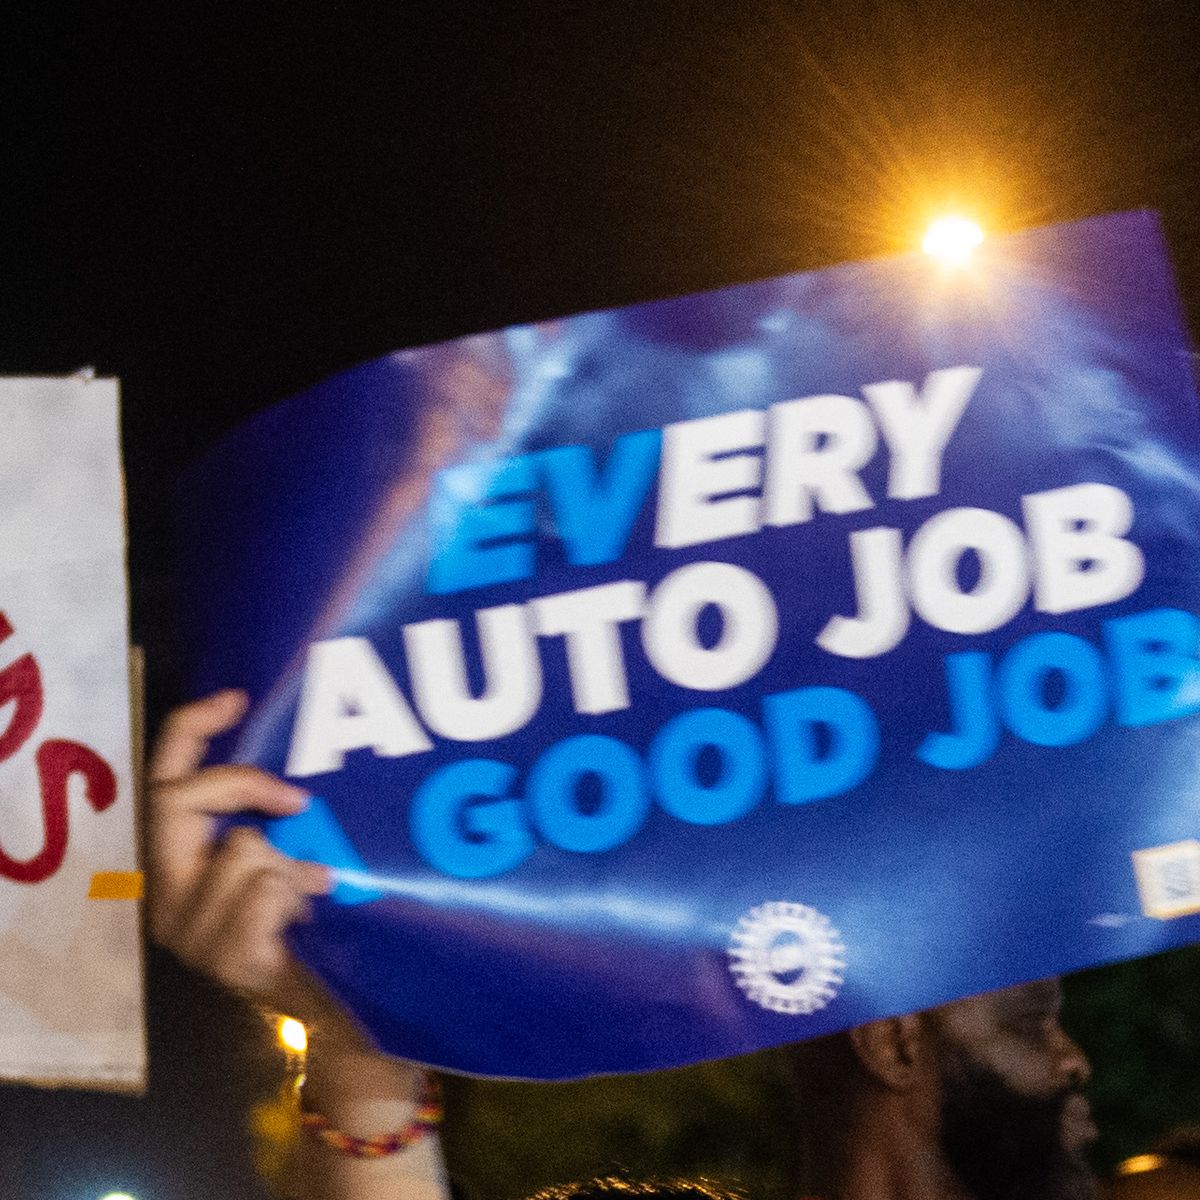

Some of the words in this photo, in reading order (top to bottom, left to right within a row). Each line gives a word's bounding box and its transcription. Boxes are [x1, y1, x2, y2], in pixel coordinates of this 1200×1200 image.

[425, 366, 984, 596] EVERY
[284, 560, 780, 778] AUTO
[816, 482, 1146, 660] JOB
[408, 685, 881, 880] GOOD
[913, 607, 1200, 771] JOB
